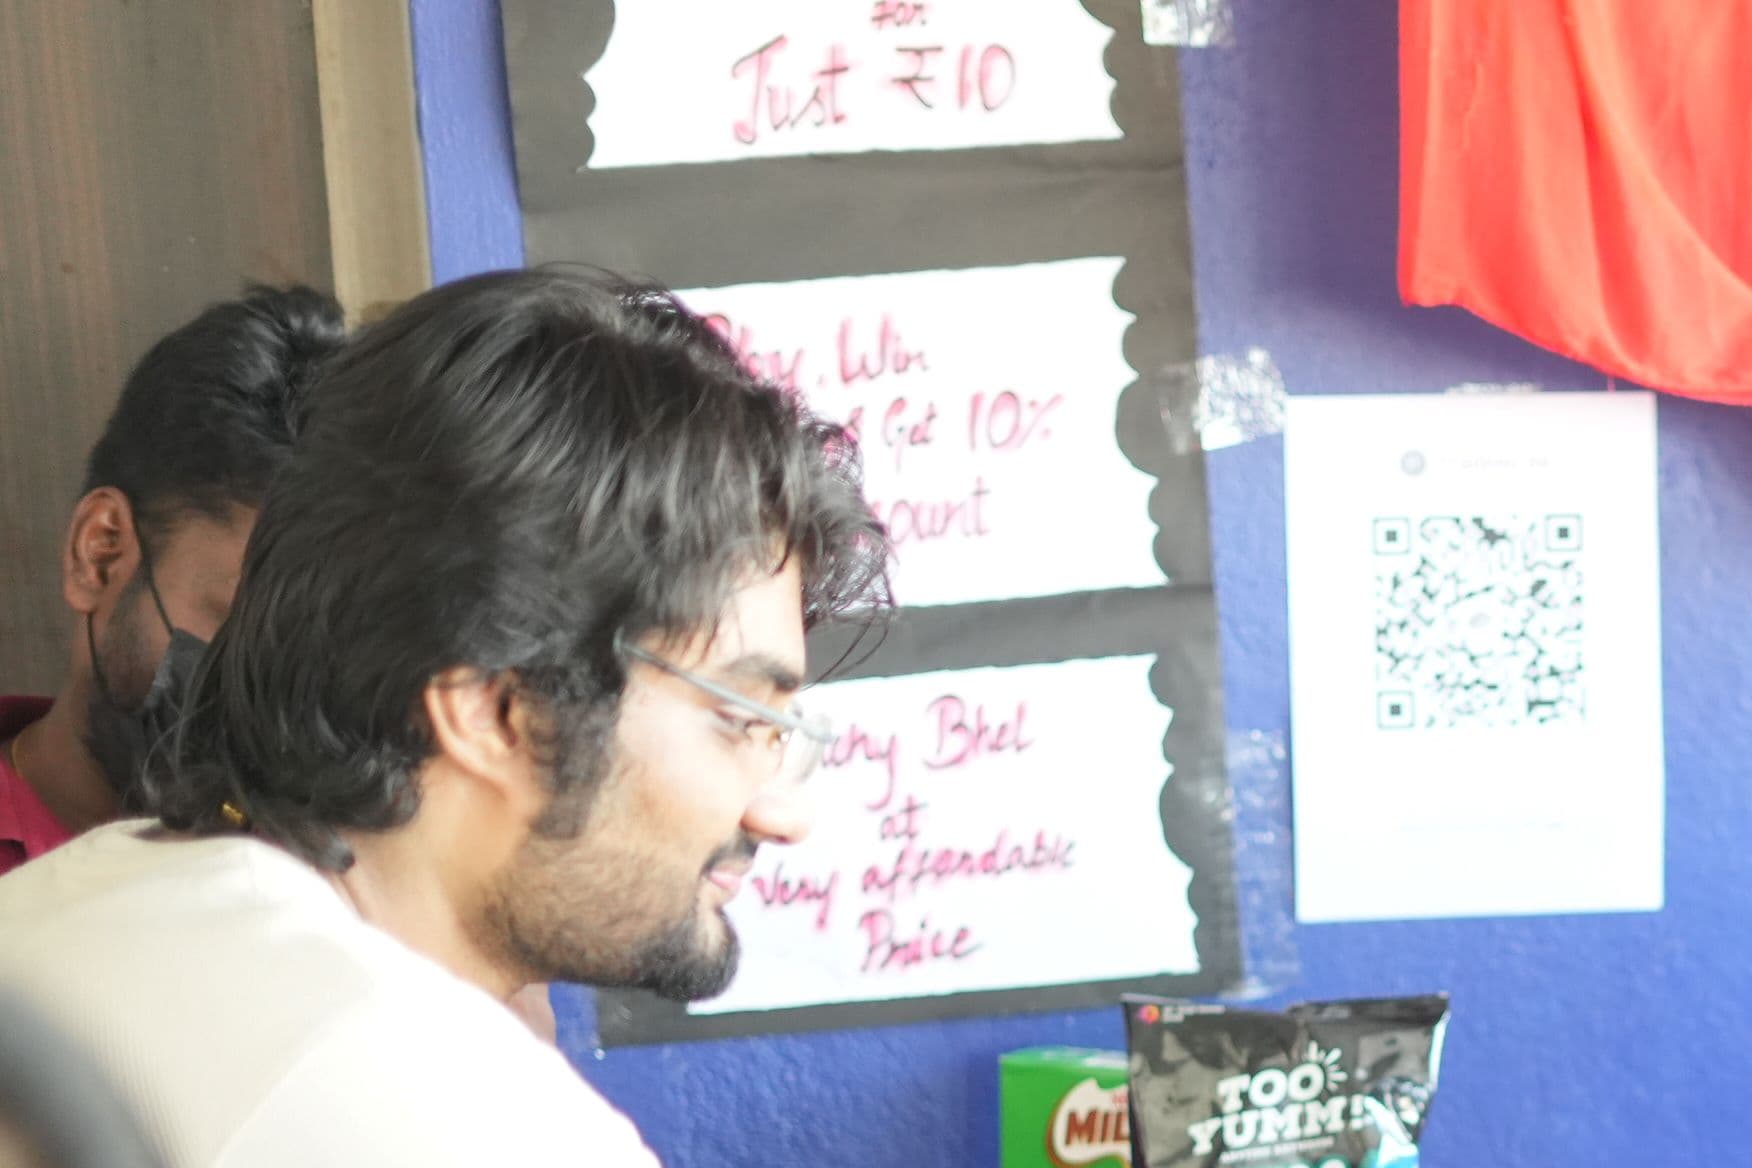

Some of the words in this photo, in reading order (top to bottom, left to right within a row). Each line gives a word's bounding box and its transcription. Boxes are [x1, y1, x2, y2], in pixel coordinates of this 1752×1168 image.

[731, 34, 851, 146] Just
[967, 389, 1064, 452] 10%
[872, 475, 991, 546] ount
[881, 795, 929, 842] at
[858, 908, 985, 974] Price
[1216, 1063, 1326, 1115] TOO
[1065, 1109, 1130, 1147] MIL
[1186, 1093, 1365, 1157] YUMM!
